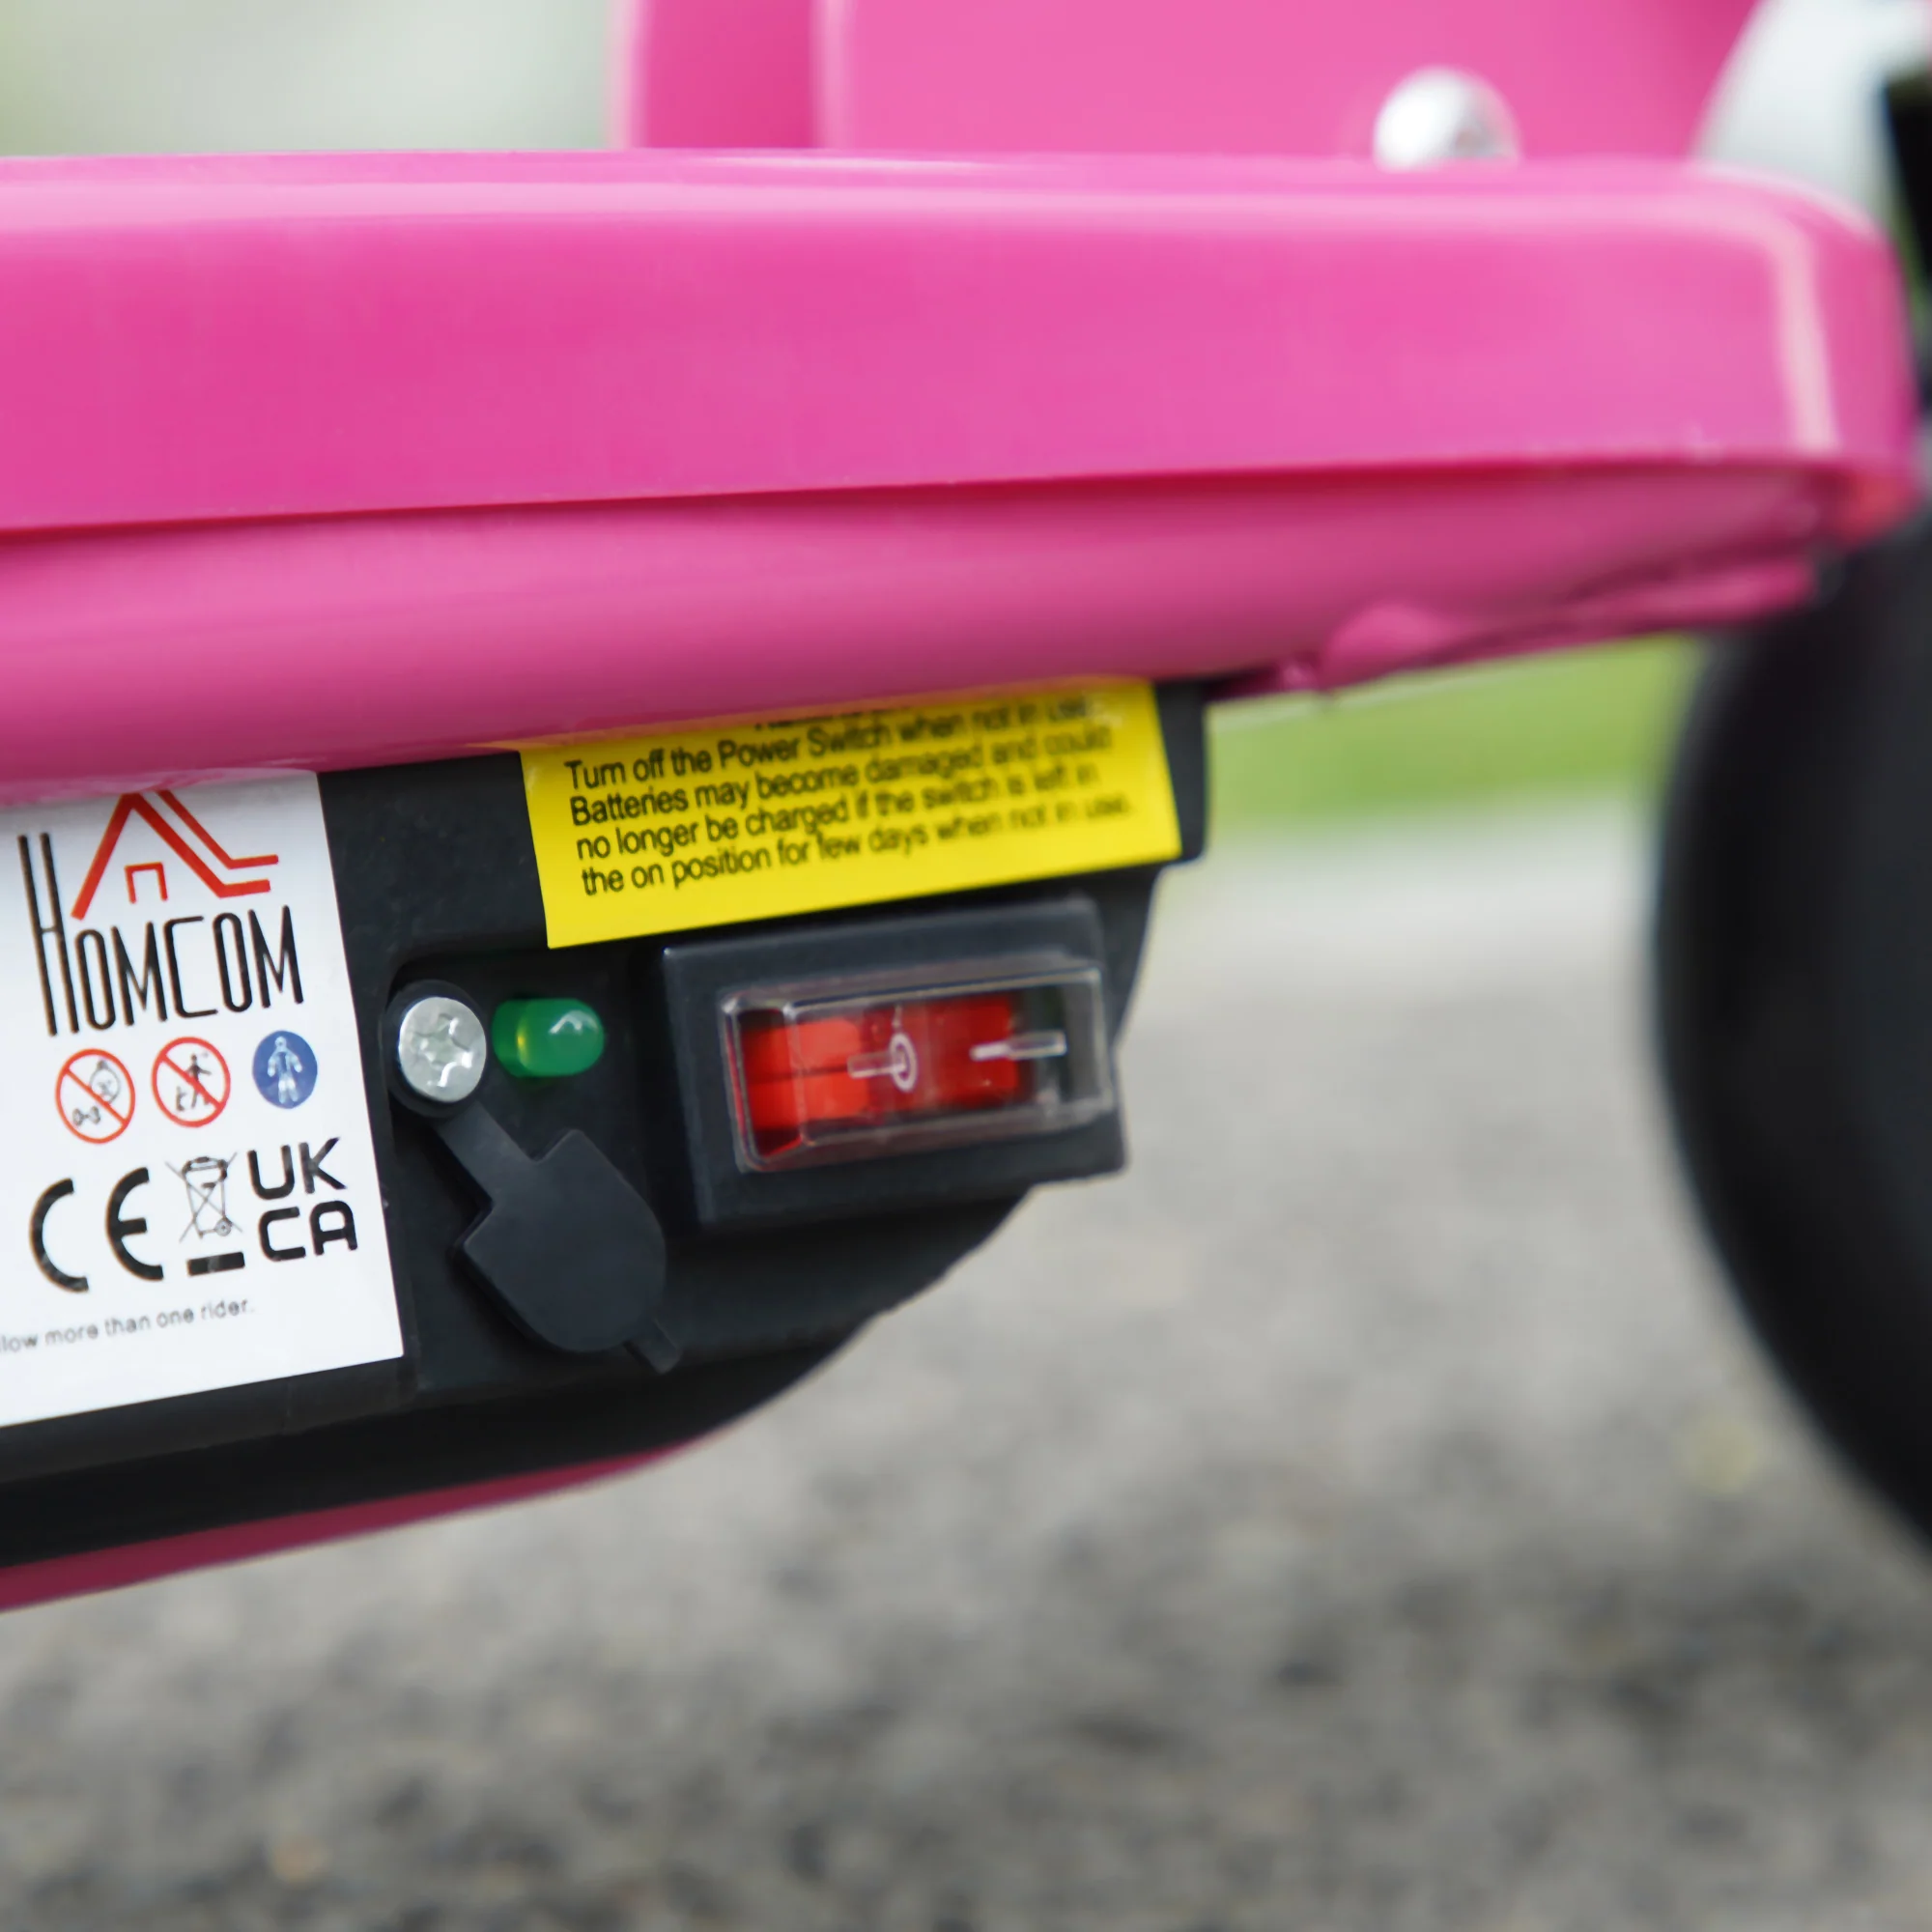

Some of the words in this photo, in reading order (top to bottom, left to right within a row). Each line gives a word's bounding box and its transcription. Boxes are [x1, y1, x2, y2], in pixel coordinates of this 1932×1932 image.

[563, 759, 627, 790] Turn
[633, 748, 666, 781] off
[670, 747, 713, 777] the
[717, 738, 801, 769] Power
[806, 715, 891, 757] Switch
[569, 784, 690, 827] Batteries
[694, 781, 750, 811] may
[753, 770, 861, 801] become
[864, 743, 985, 783] damaged
[991, 731, 1037, 764] and
[1043, 722, 1113, 756] could
[576, 836, 611, 860] no
[615, 822, 698, 858] longer
[704, 814, 739, 842] be
[745, 792, 850, 837] charged
[854, 788, 870, 820] if
[873, 783, 916, 817] the
[921, 772, 999, 811] switch
[1006, 770, 1028, 797] is
[582, 866, 625, 896] the
[630, 863, 665, 889] on
[671, 845, 772, 890] position
[777, 837, 810, 867] for
[816, 830, 863, 861] few
[868, 818, 928, 858] days
[935, 810, 1000, 841] when
[1008, 799, 1047, 831] not
[1053, 795, 1078, 823] in
[246, 1137, 347, 1200] UK
[29, 1167, 164, 1293] CE
[258, 1200, 358, 1262] CA
[0, 1334, 38, 1353] low
[44, 1324, 99, 1347] more
[104, 1316, 151, 1337] than
[156, 1307, 194, 1329] one
